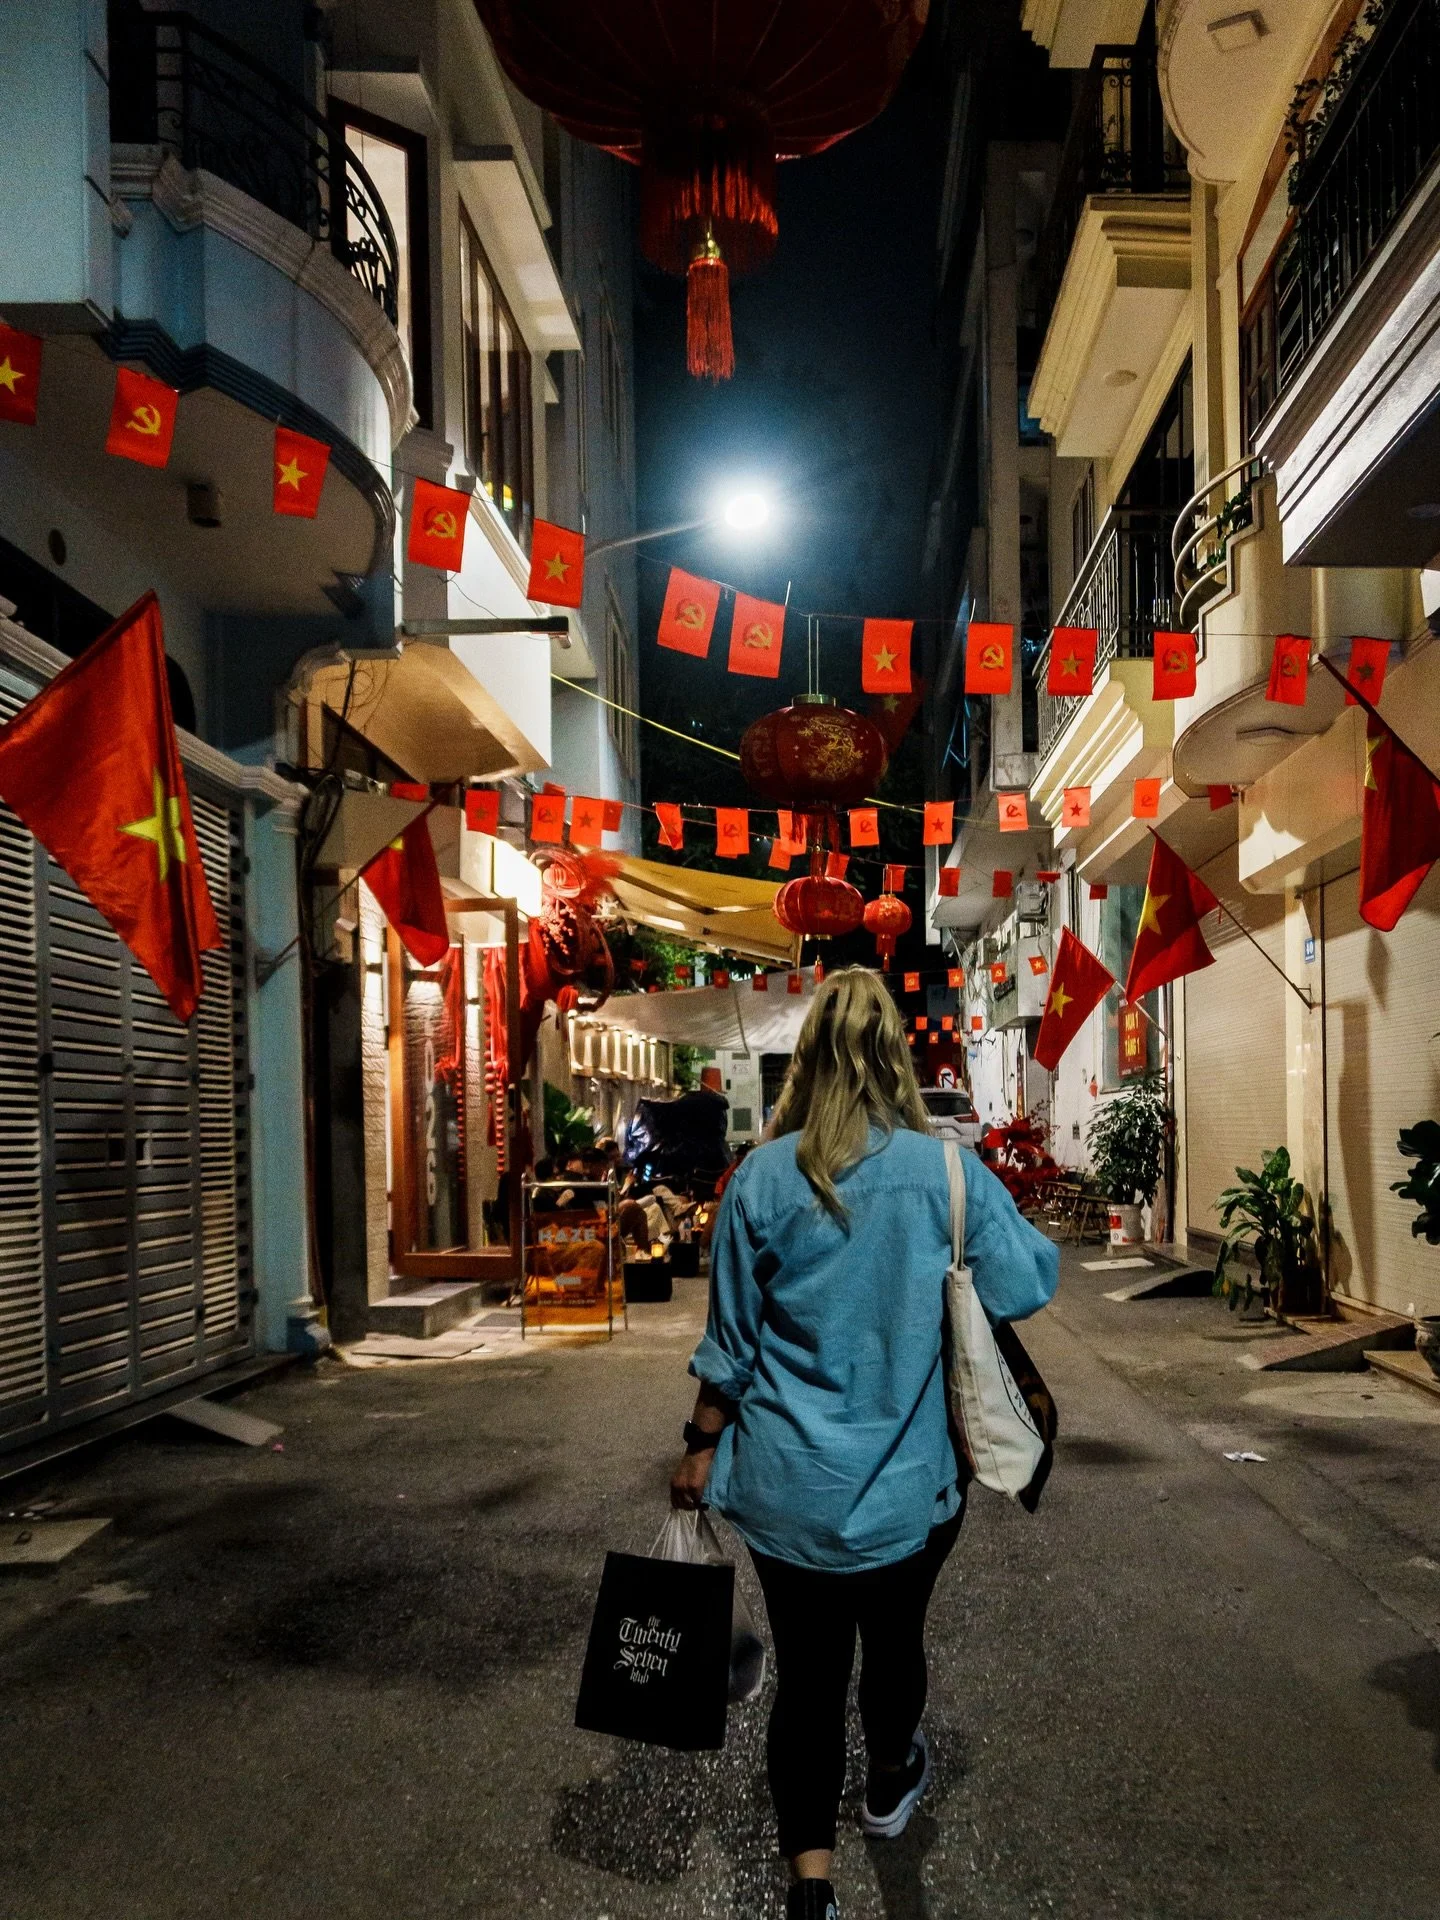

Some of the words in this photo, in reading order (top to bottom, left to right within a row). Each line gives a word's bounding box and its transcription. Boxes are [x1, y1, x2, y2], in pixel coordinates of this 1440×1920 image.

[538, 1226, 597, 1242] HAZE
[619, 1617, 682, 1653] Twenty
[613, 1645, 668, 1677] Seven
